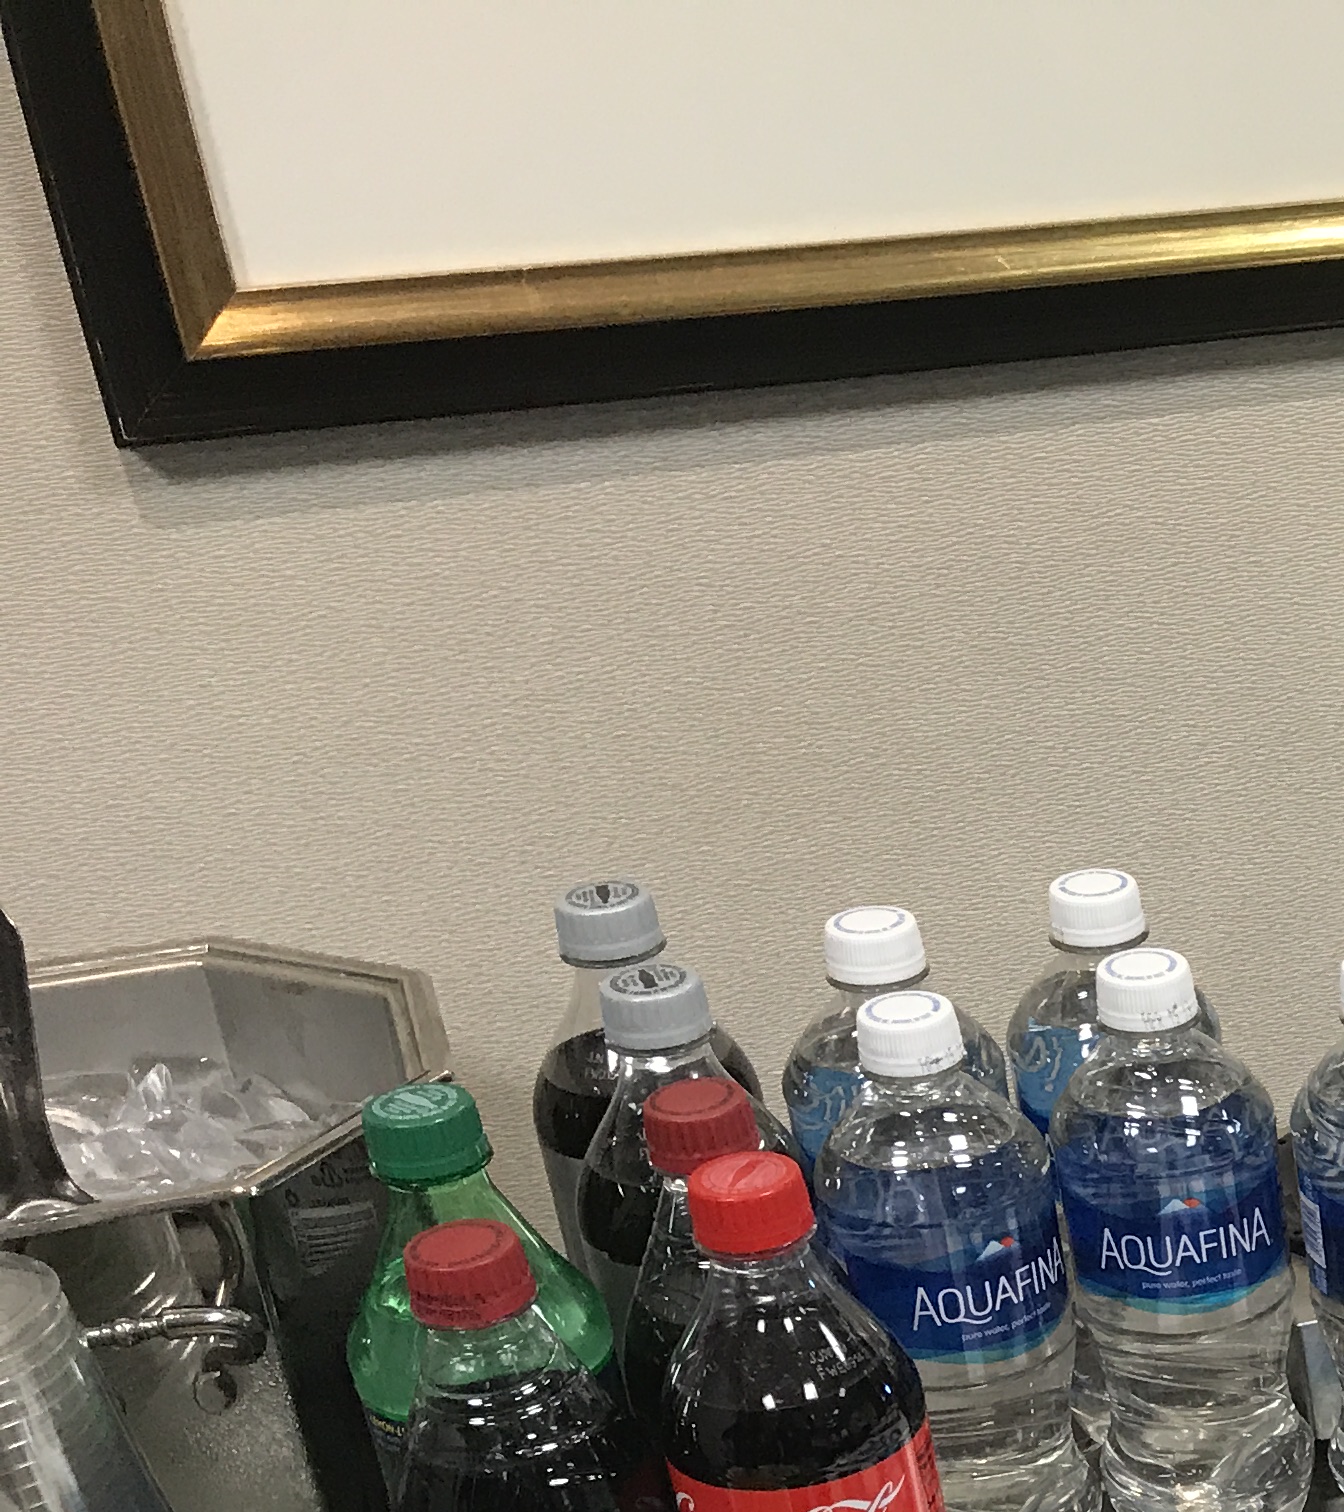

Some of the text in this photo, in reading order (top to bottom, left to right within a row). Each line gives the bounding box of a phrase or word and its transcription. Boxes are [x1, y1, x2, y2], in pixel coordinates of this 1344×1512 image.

[1100, 1206, 1271, 1276] AQUAFINA
[912, 1236, 1066, 1331] AQUAFINA
[1141, 1280, 1161, 1290] pure
[1191, 1274, 1222, 1288] perfect
[961, 1330, 983, 1342] pure
